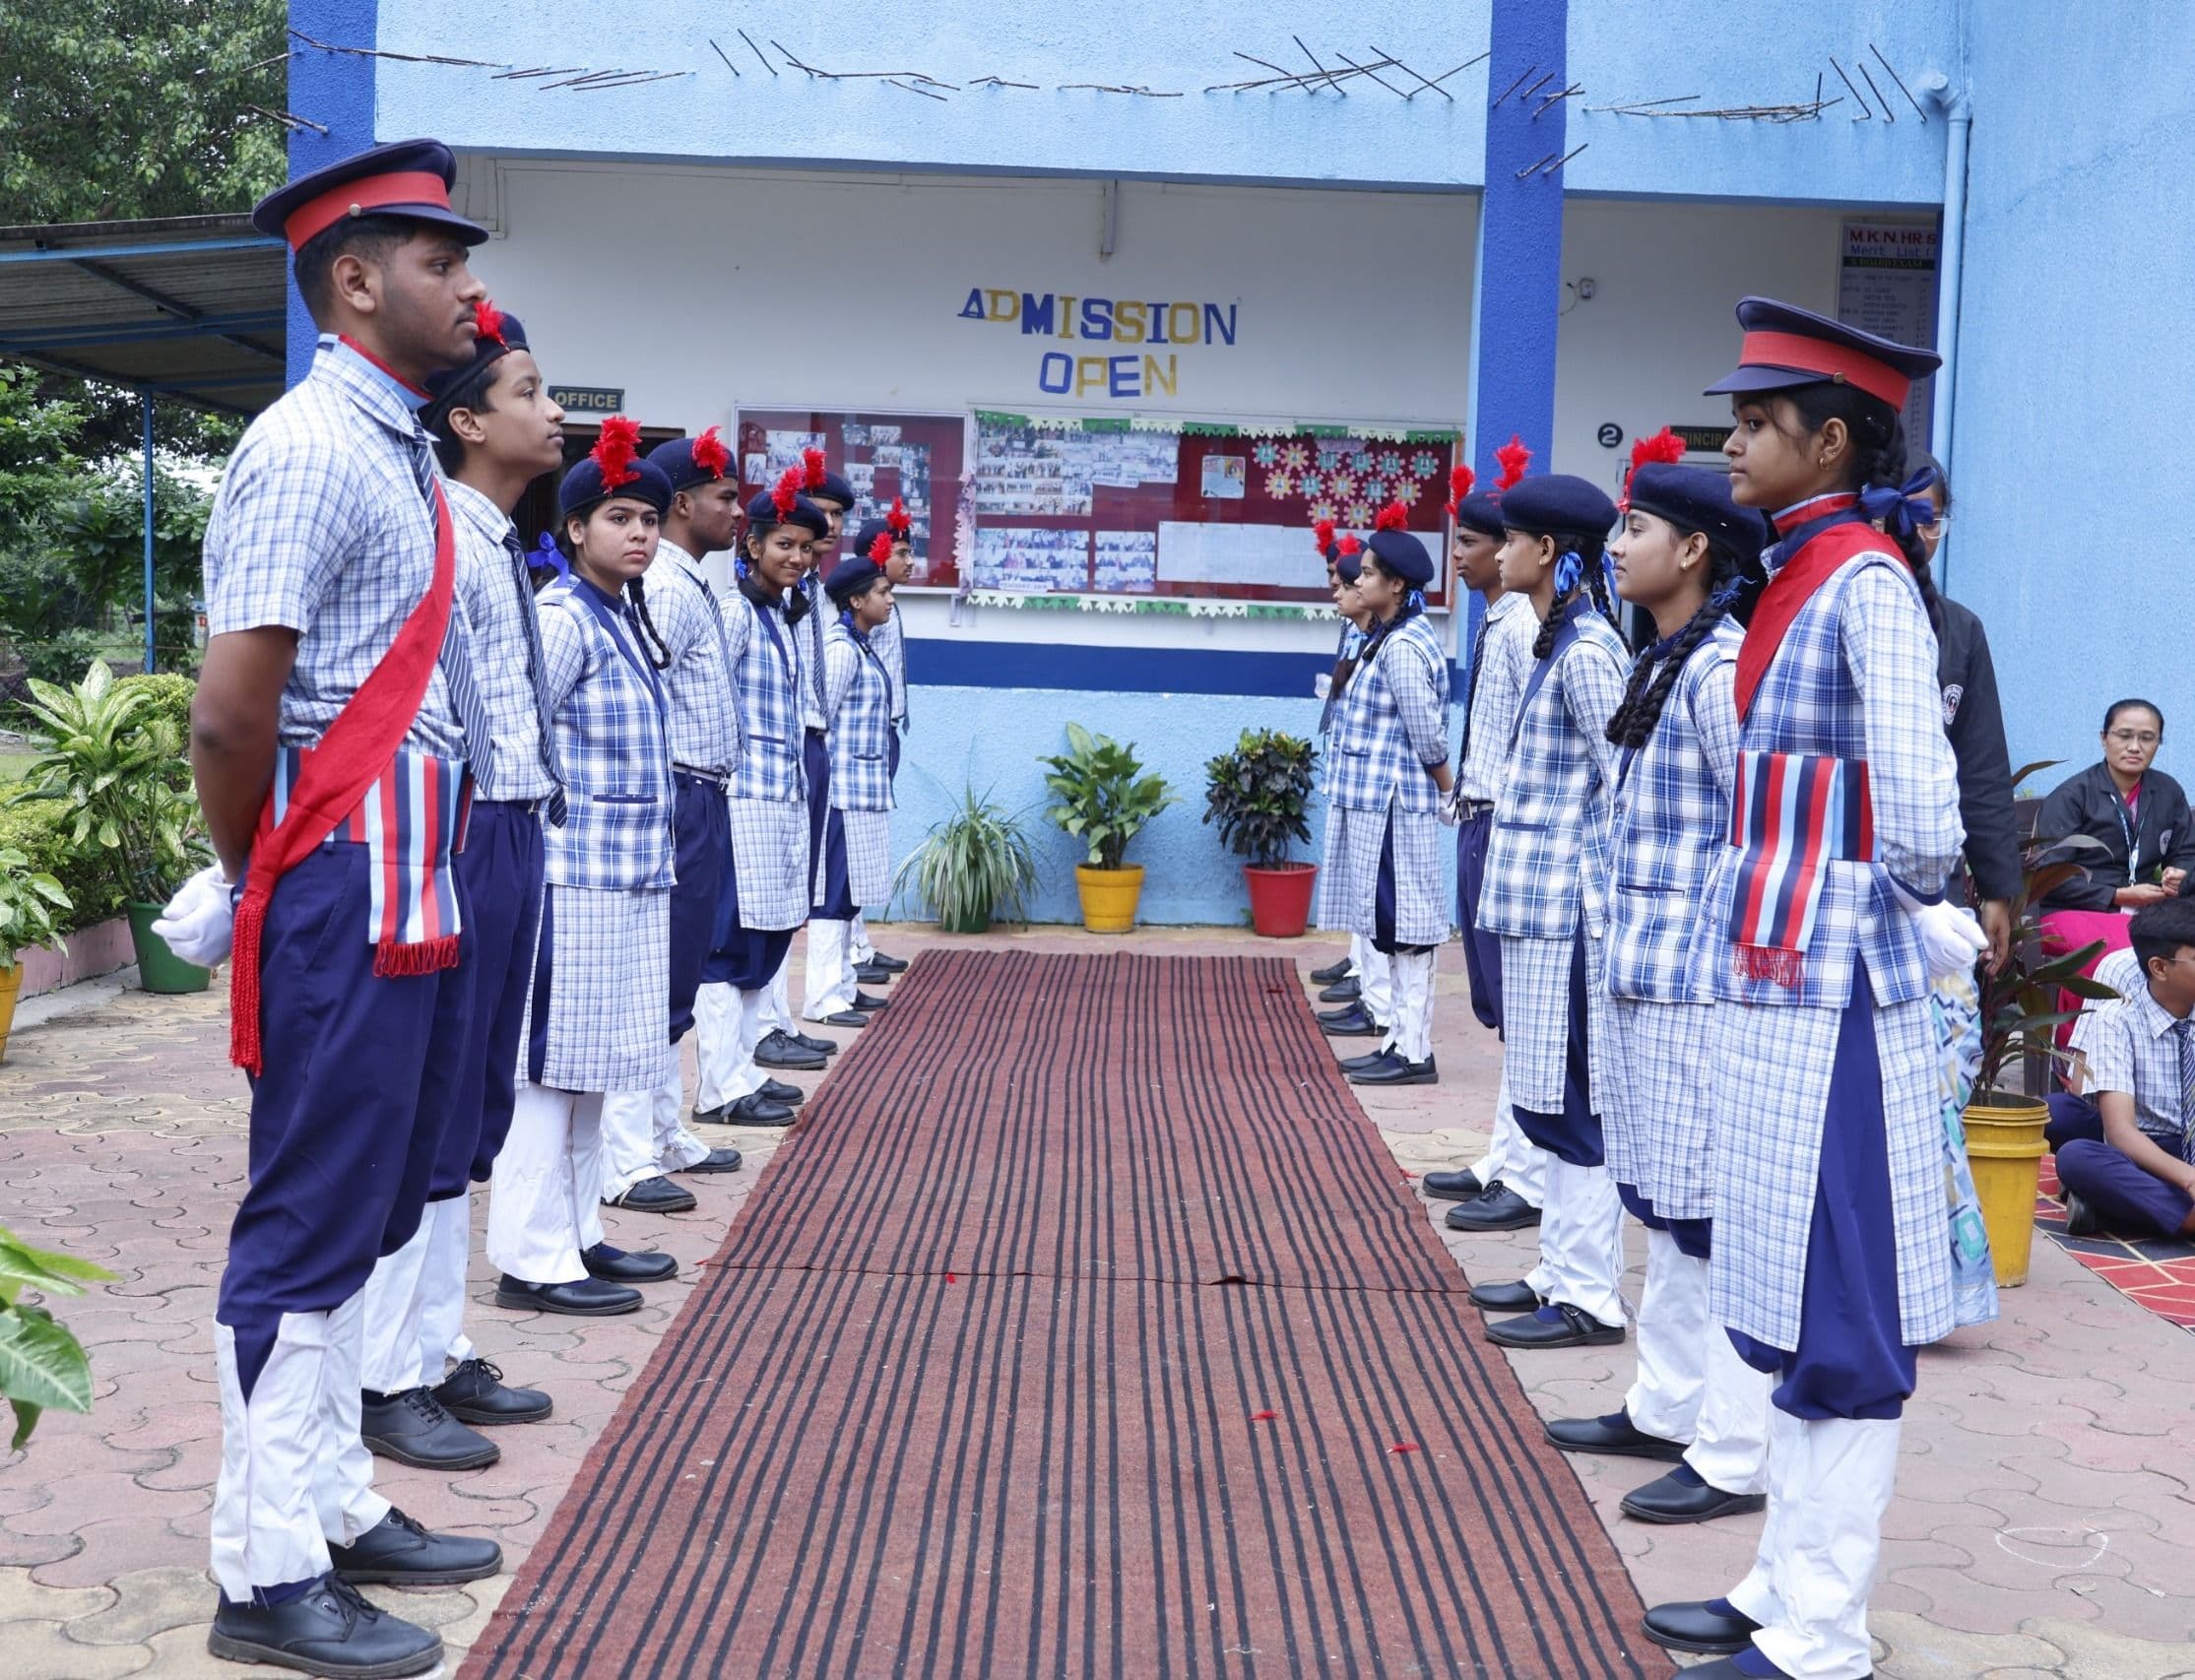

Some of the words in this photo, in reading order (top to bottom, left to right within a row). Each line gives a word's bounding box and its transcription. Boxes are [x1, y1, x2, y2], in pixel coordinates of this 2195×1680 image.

[1850, 244, 1887, 257] Merit
[957, 289, 1237, 346] ADMISSION
[1039, 352, 1177, 398] OPEN
[554, 391, 617, 408] OFFICE
[1601, 426, 1618, 444] 2
